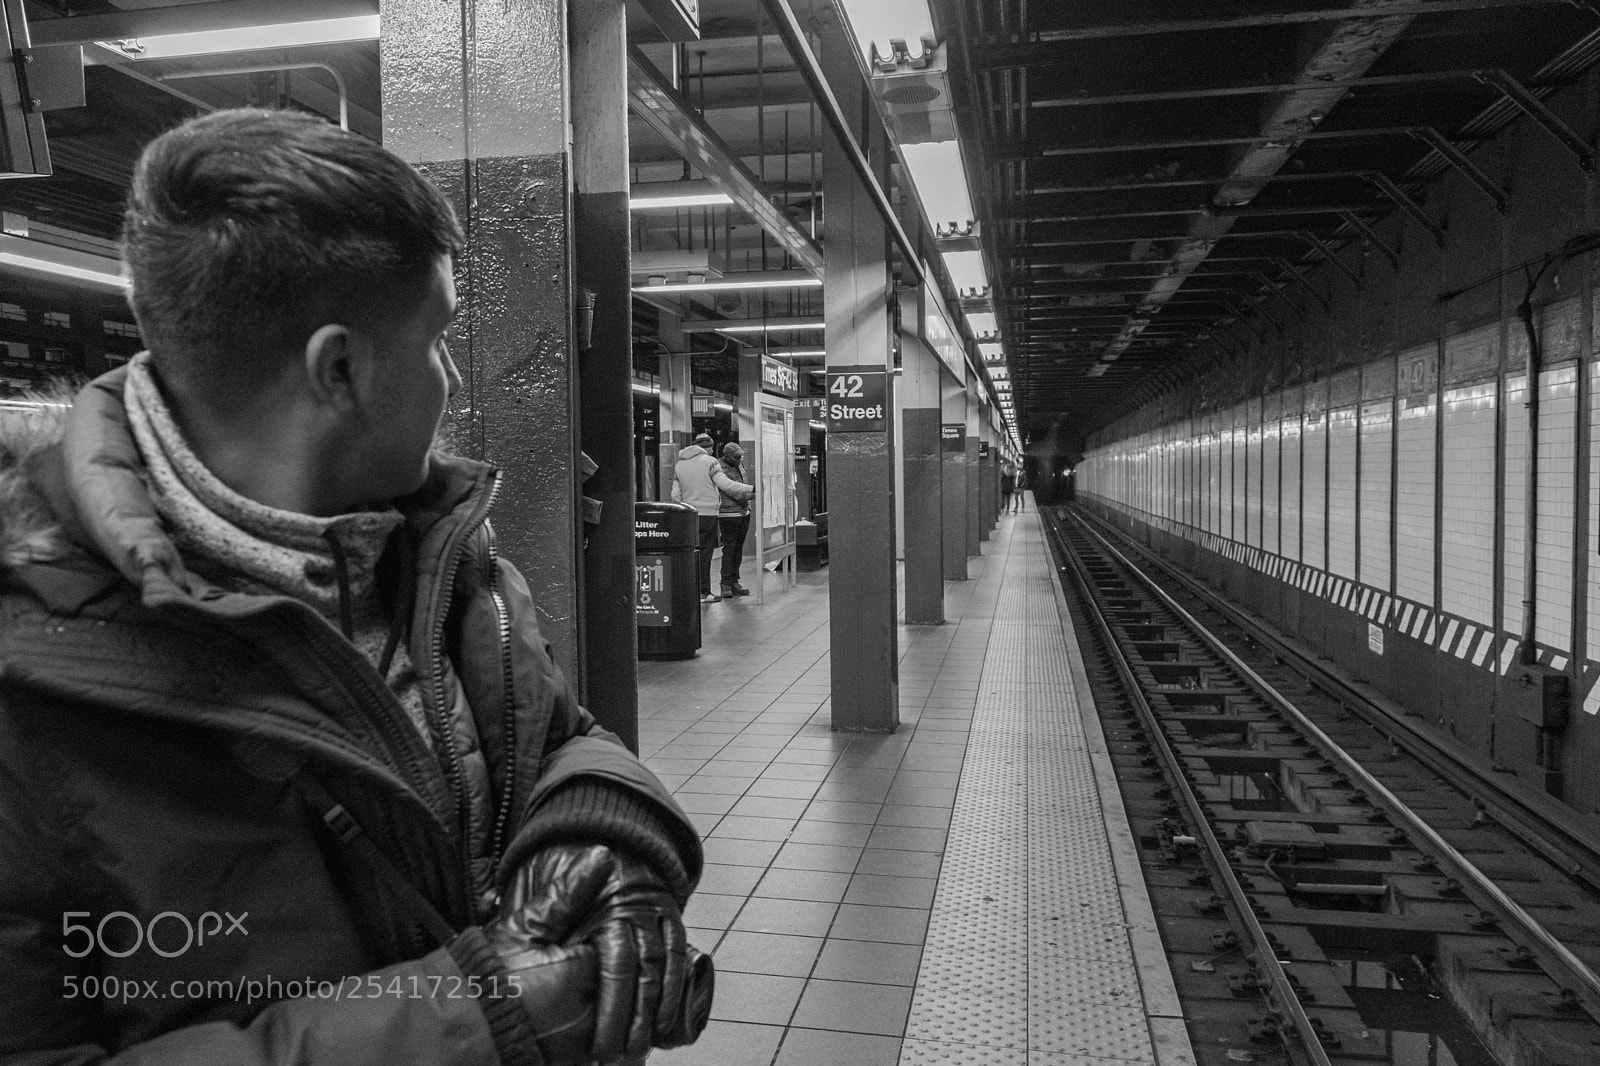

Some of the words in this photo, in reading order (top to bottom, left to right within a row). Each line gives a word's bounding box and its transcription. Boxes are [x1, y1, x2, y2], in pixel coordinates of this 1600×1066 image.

[830, 375, 863, 398] 42
[794, 399, 810, 408] Exit
[831, 404, 882, 420] Street
[634, 531, 648, 539] ops
[649, 530, 670, 538] Here
